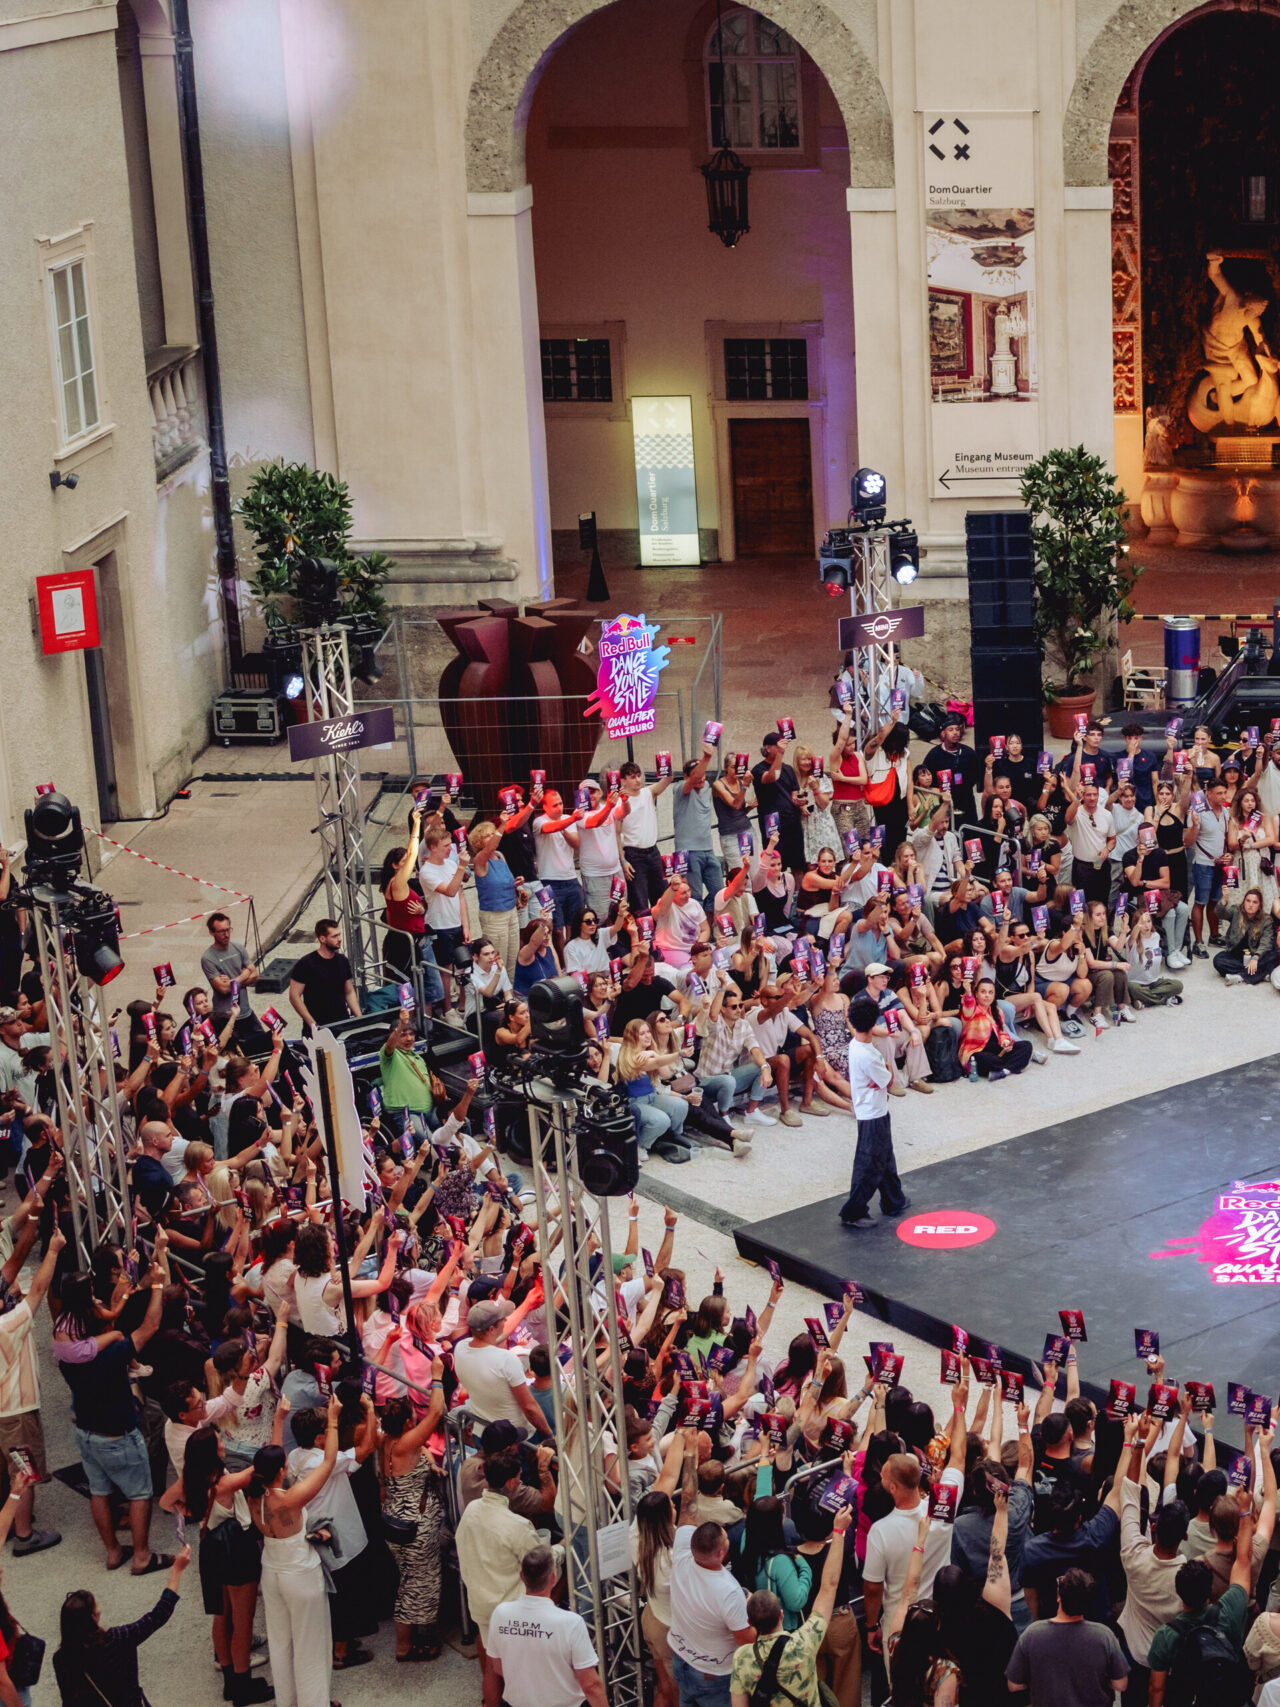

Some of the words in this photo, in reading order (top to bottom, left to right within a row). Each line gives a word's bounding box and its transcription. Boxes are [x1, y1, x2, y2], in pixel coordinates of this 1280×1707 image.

[930, 185, 992, 193] DomQuartier
[930, 197, 966, 207] Salzburg
[955, 453, 992, 463] Eingang
[994, 452, 1034, 460] Museum
[602, 640, 625, 656] Red
[628, 633, 650, 650] Bull
[610, 651, 648, 680] DANCE
[614, 665, 654, 694] YOUR
[614, 680, 652, 713] STYLE
[608, 709, 655, 728] QUALIFIER
[320, 721, 364, 742] Kiehl's
[610, 722, 654, 738] SALZBURG
[1046, 1350, 1062, 1359] BLUE
[880, 1371, 894, 1379] RED
[946, 1370, 958, 1379] RED
[1007, 1388, 1019, 1396] RED
[1114, 1400, 1128, 1408] RED
[1248, 1412, 1265, 1420] BLUE
[832, 1434, 844, 1444] RED
[1231, 1472, 1247, 1482] BLUE
[826, 1492, 846, 1504] BLUE
[508, 1620, 540, 1629] I.S.P.M
[499, 1626, 553, 1639] SECURITY
